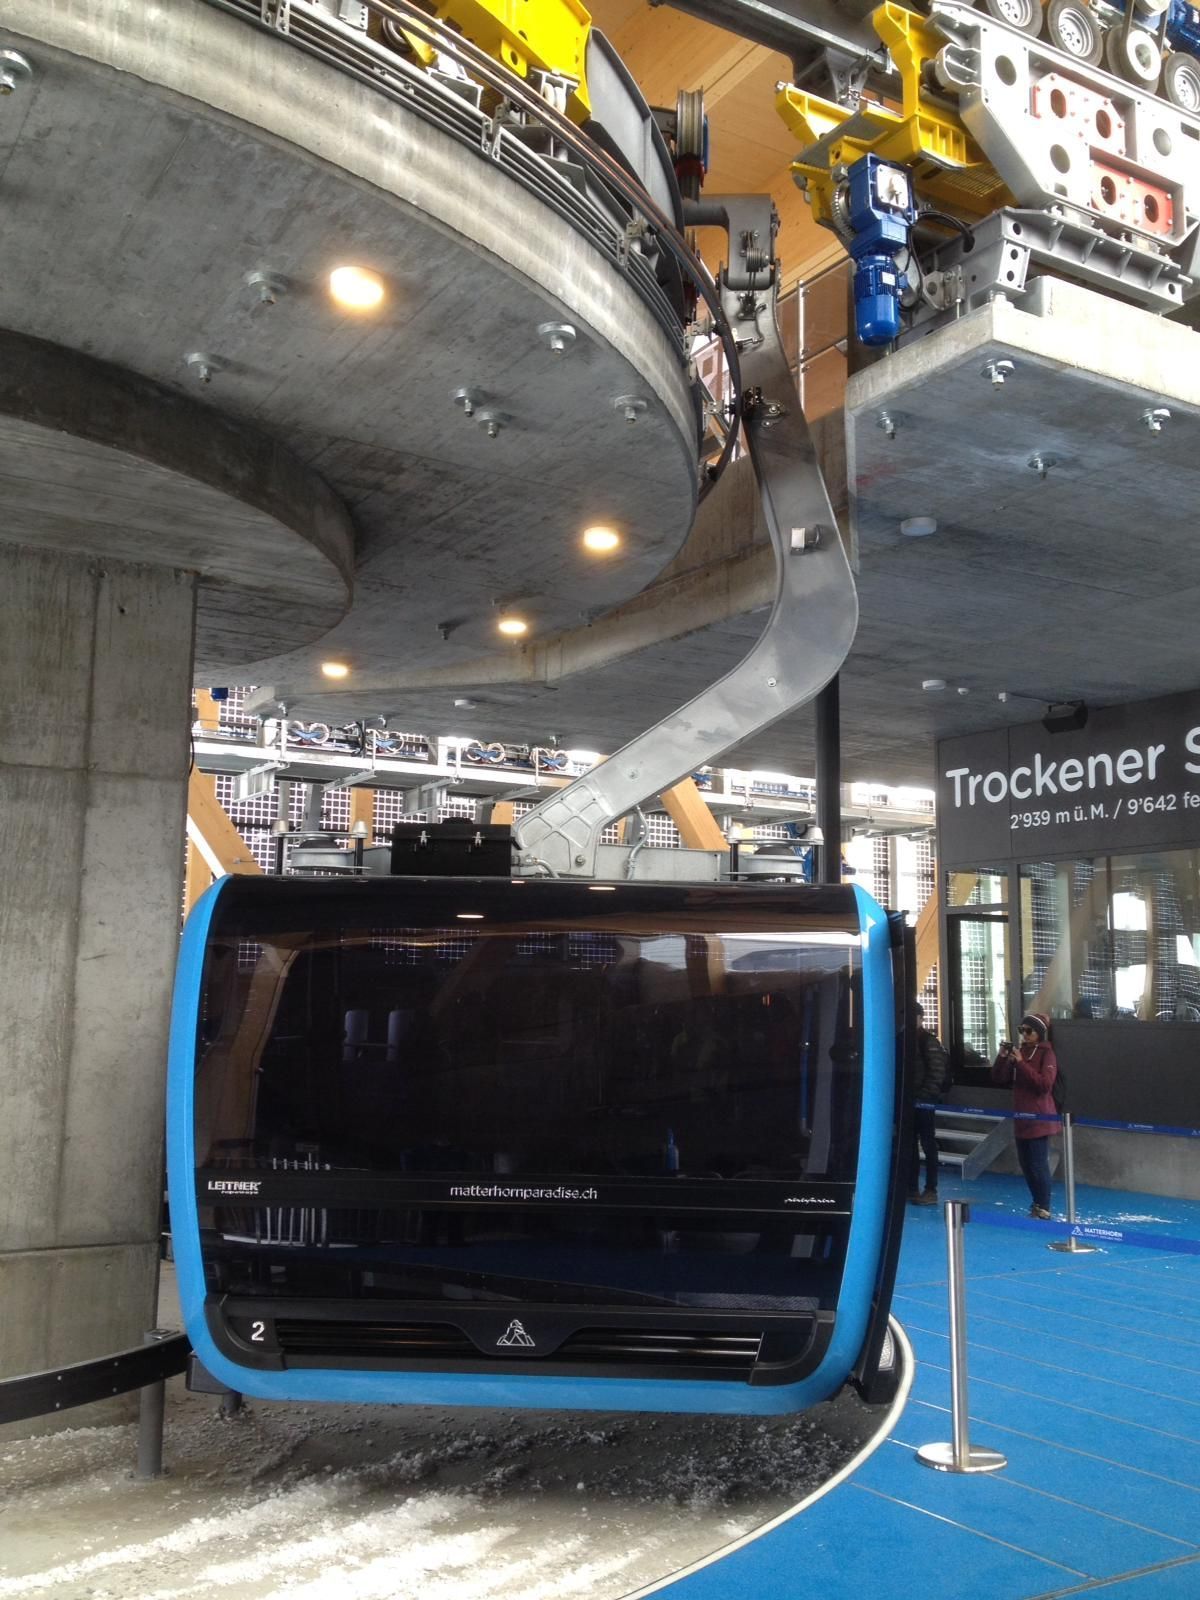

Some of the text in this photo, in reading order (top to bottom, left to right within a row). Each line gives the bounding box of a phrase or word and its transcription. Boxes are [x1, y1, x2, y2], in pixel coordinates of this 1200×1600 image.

[945, 743, 1166, 808] Trockener
[1010, 810, 1051, 829] 2'939
[1127, 793, 1177, 815] 9'642
[208, 1180, 262, 1191] LEITNER
[449, 1184, 598, 1200] matterhornparadise.ch
[251, 1321, 265, 1341] 2
